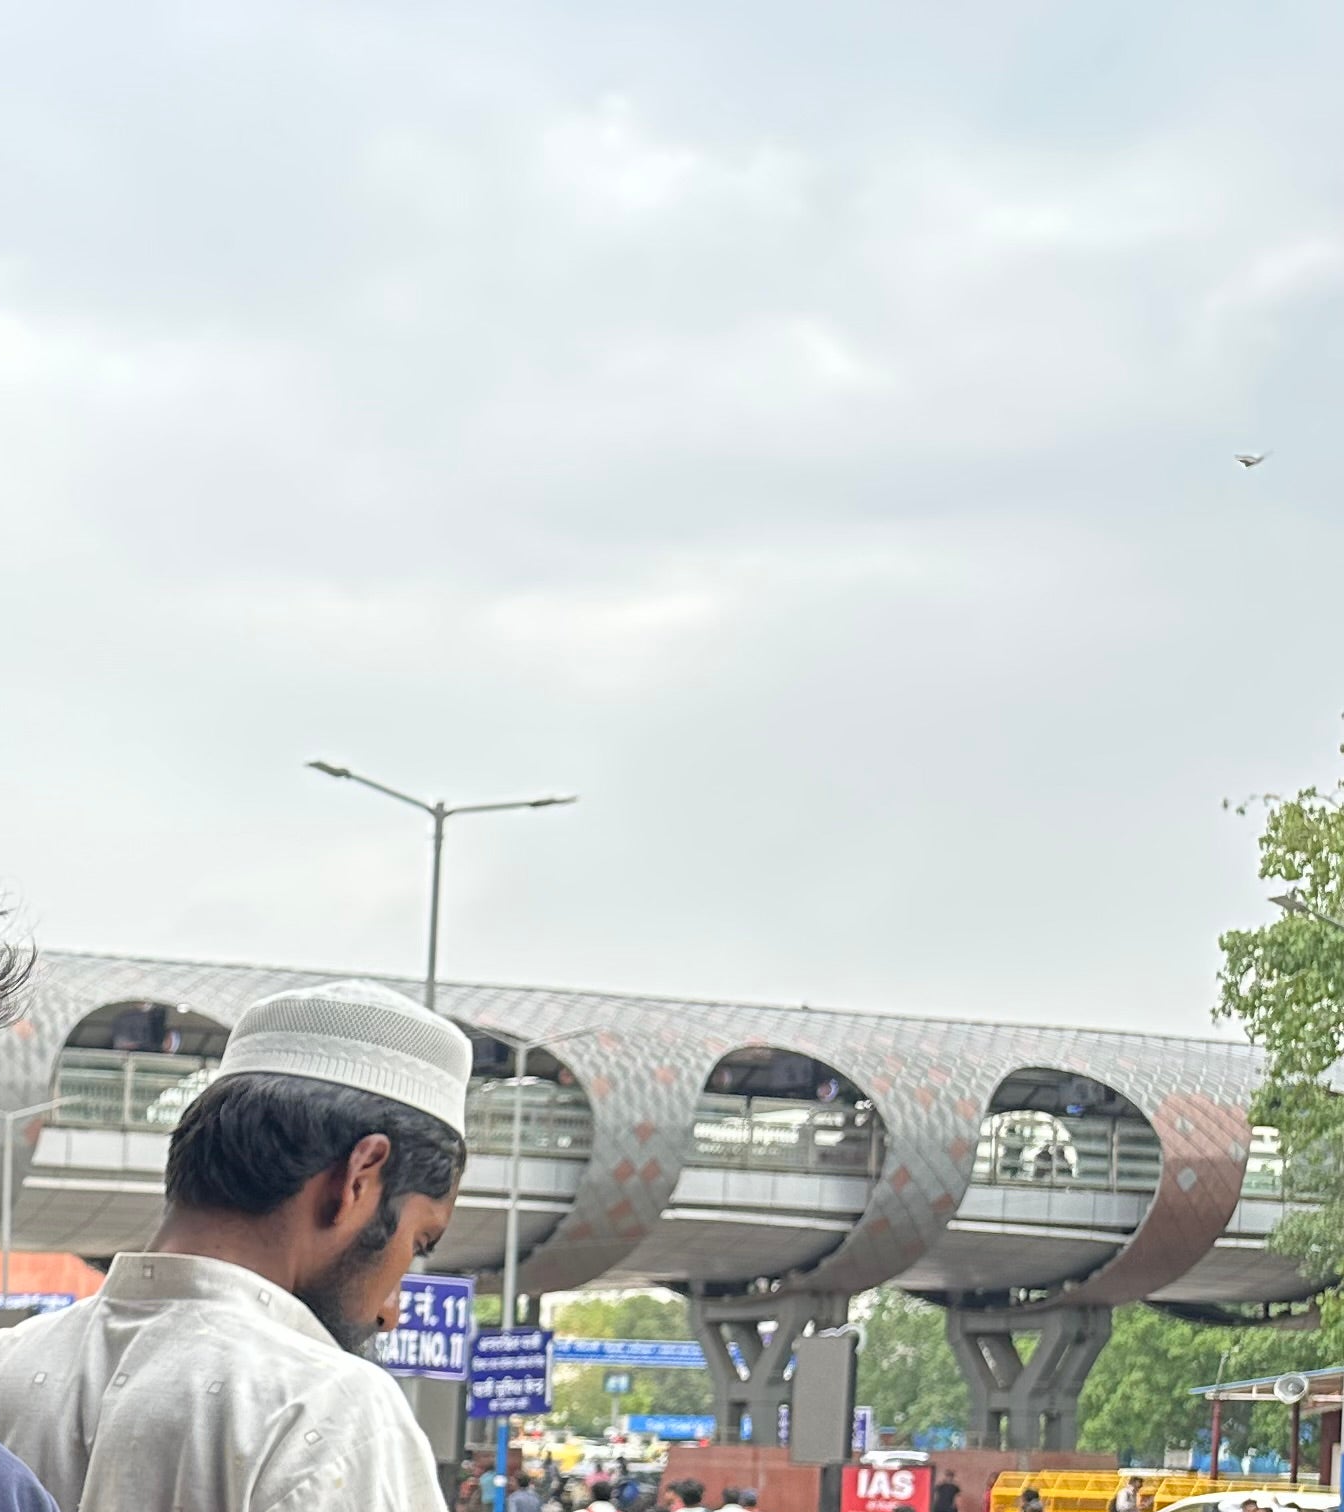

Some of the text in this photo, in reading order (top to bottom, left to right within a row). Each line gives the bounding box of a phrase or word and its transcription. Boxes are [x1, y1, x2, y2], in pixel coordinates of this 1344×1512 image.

[443, 1296, 466, 1328] 11
[419, 1331, 448, 1368] NO.
[450, 1333, 464, 1369] 11
[857, 1469, 915, 1500] IAS
